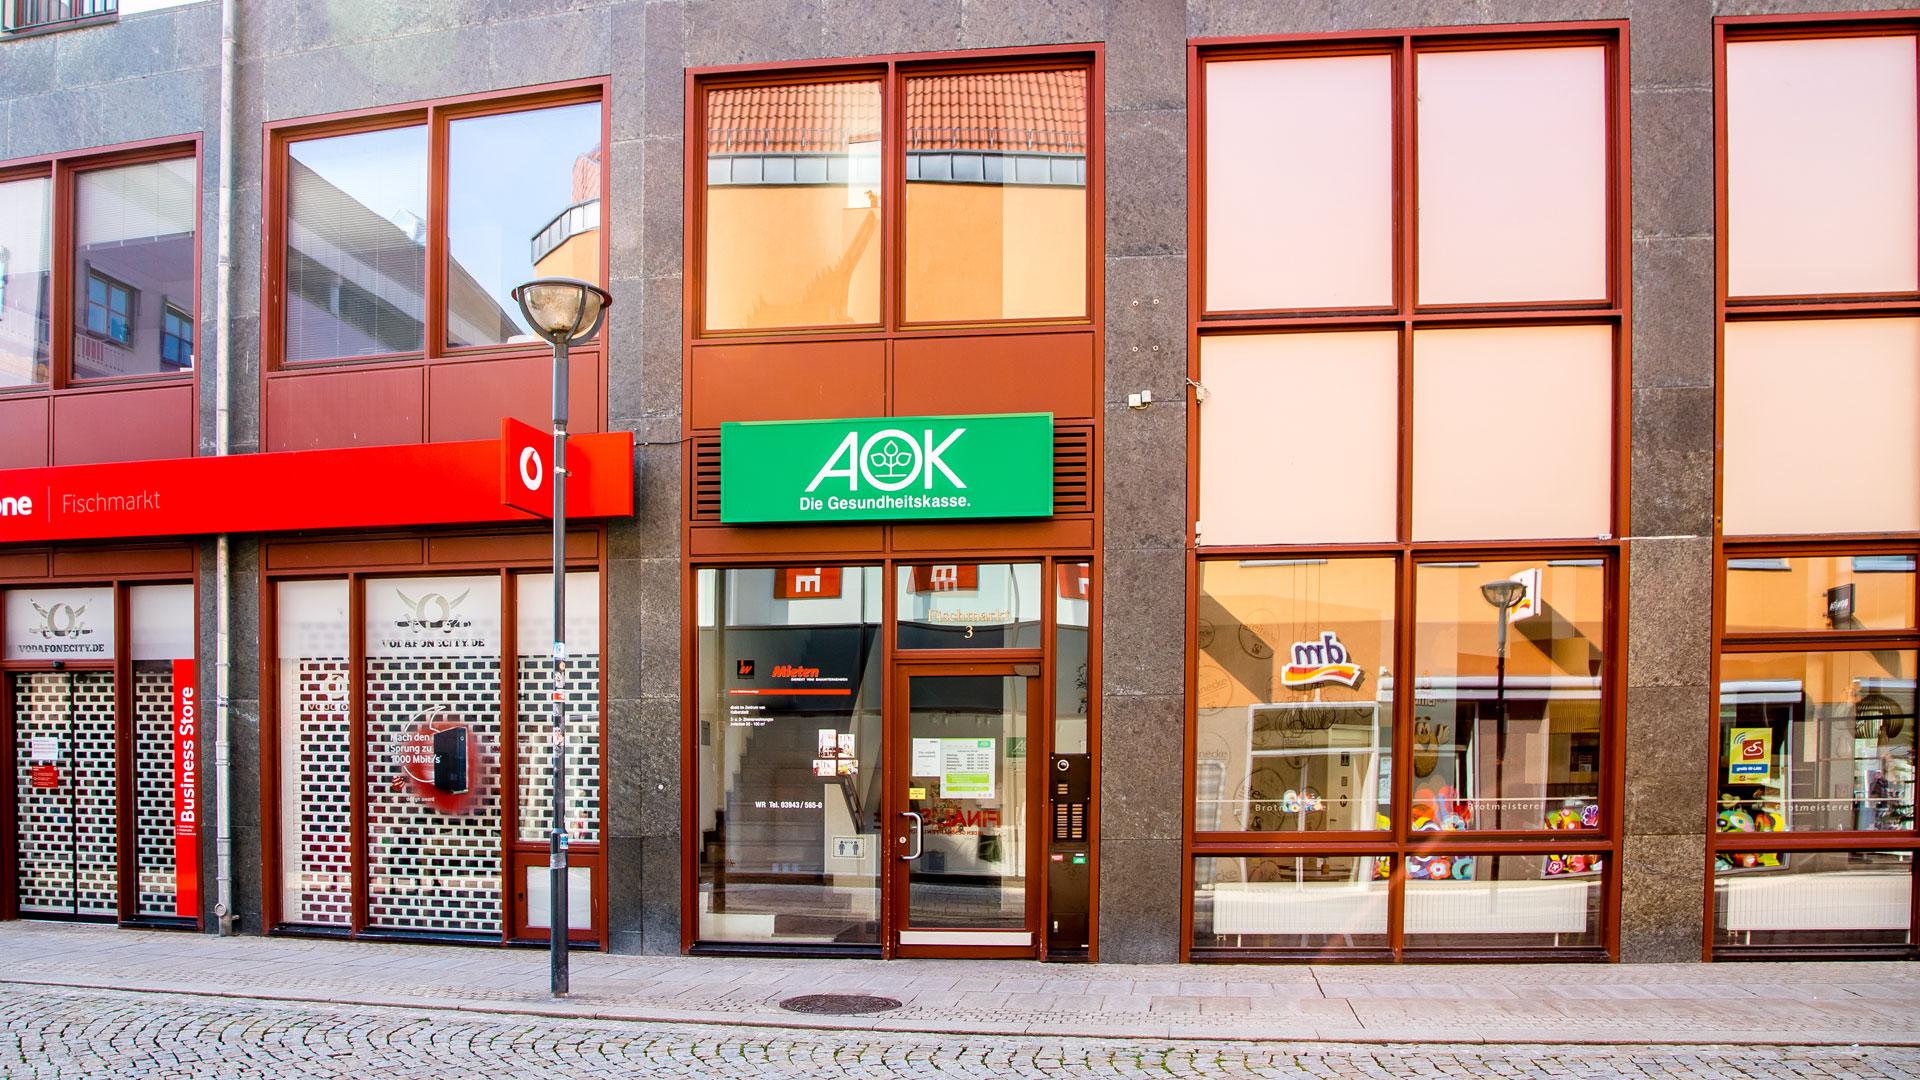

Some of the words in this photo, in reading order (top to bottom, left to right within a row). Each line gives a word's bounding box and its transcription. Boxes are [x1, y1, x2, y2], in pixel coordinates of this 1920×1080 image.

[804, 428, 968, 492] AOK
[0, 495, 32, 516] ne
[62, 490, 161, 513] Fischmarkt
[800, 497, 823, 511] Die
[828, 494, 972, 510] Gesundheitskasse.
[964, 625, 974, 639] 3
[18, 643, 105, 653] VODAFONECITY.DE
[771, 664, 820, 678] Mieten
[179, 687, 194, 736] Store
[414, 733, 430, 742] den
[390, 744, 420, 754] Sprung
[422, 745, 432, 753] zu
[391, 754, 411, 764] 1000
[180, 740, 195, 822] Business
[768, 801, 780, 809] Tel.
